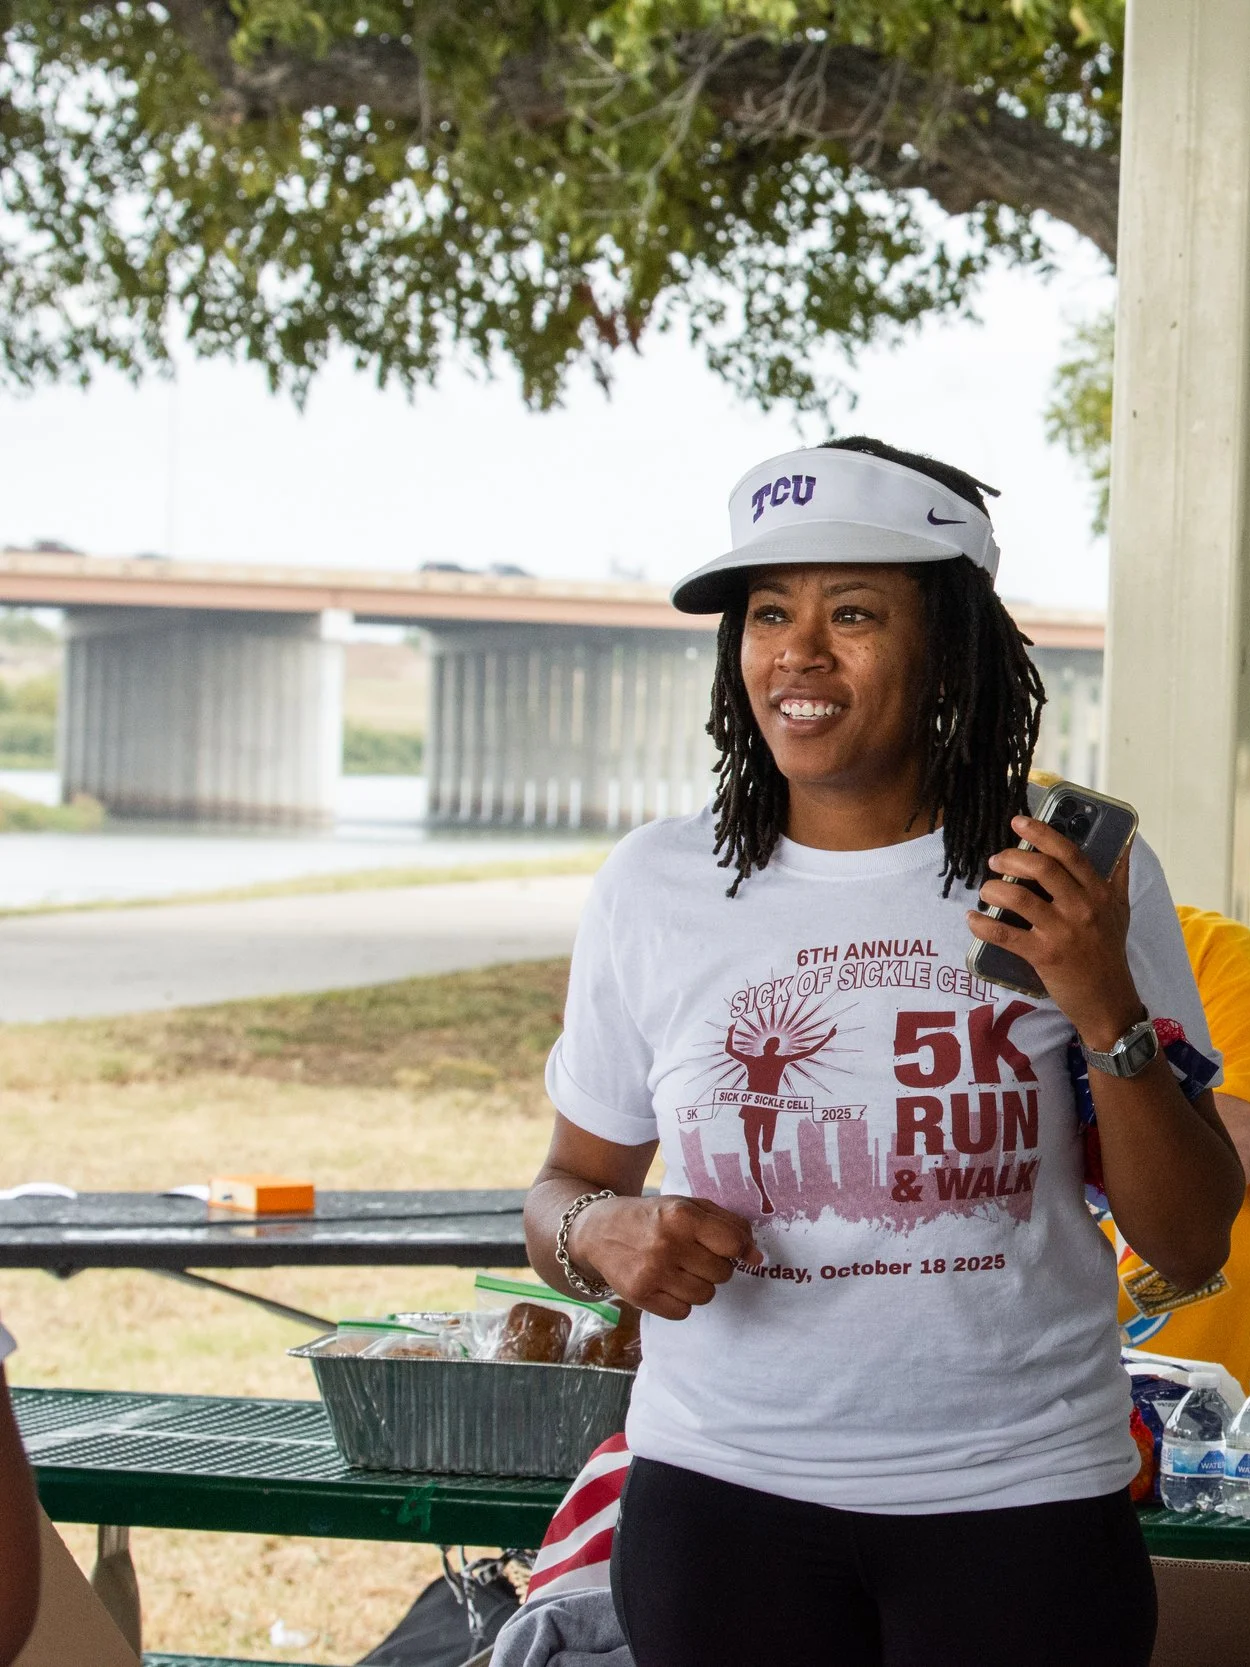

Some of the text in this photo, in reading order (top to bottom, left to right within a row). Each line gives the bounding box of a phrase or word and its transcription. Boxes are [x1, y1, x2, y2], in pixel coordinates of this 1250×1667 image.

[751, 474, 817, 524] TCU
[796, 939, 939, 967] 6TH ANNUAL
[730, 975, 793, 1018] SICK
[796, 966, 832, 997] OF
[837, 960, 931, 991] SICKLE
[893, 1000, 1039, 1089] 5K
[686, 1108, 698, 1120] 5K
[719, 1091, 809, 1110] SICK OF SICKLE CELL
[821, 1107, 852, 1121] 2025
[895, 1089, 1039, 1157] RUN
[891, 1158, 1038, 1203] & WALK
[819, 1259, 912, 1280] October
[919, 1258, 946, 1275] 18
[952, 1253, 1006, 1272] 2025
